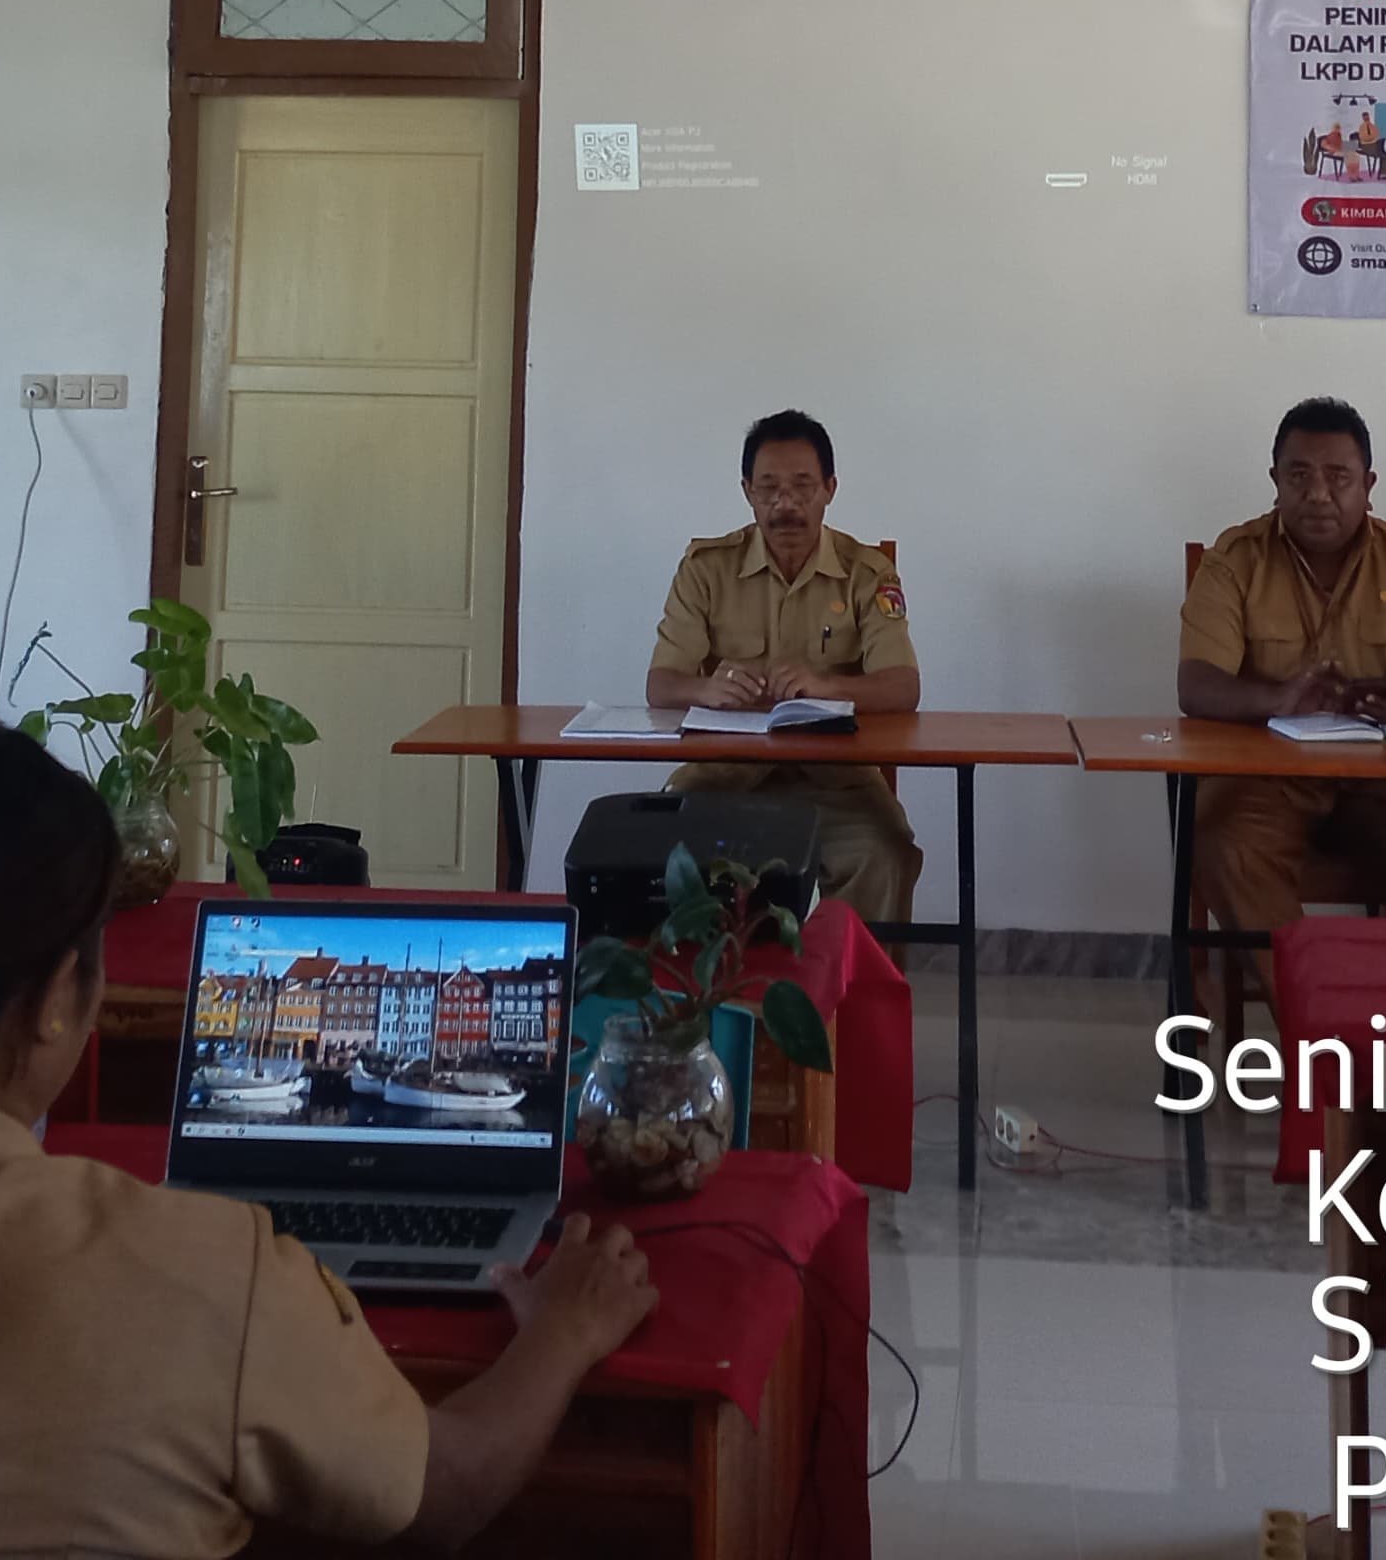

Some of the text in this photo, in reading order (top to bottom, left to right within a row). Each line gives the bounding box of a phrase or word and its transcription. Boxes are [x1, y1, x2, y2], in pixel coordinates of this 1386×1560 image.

[1289, 34, 1377, 54] DALAM
[1300, 62, 1365, 82] LKPD
[1110, 155, 1168, 170] No Signal
[1350, 243, 1373, 253] Visit
